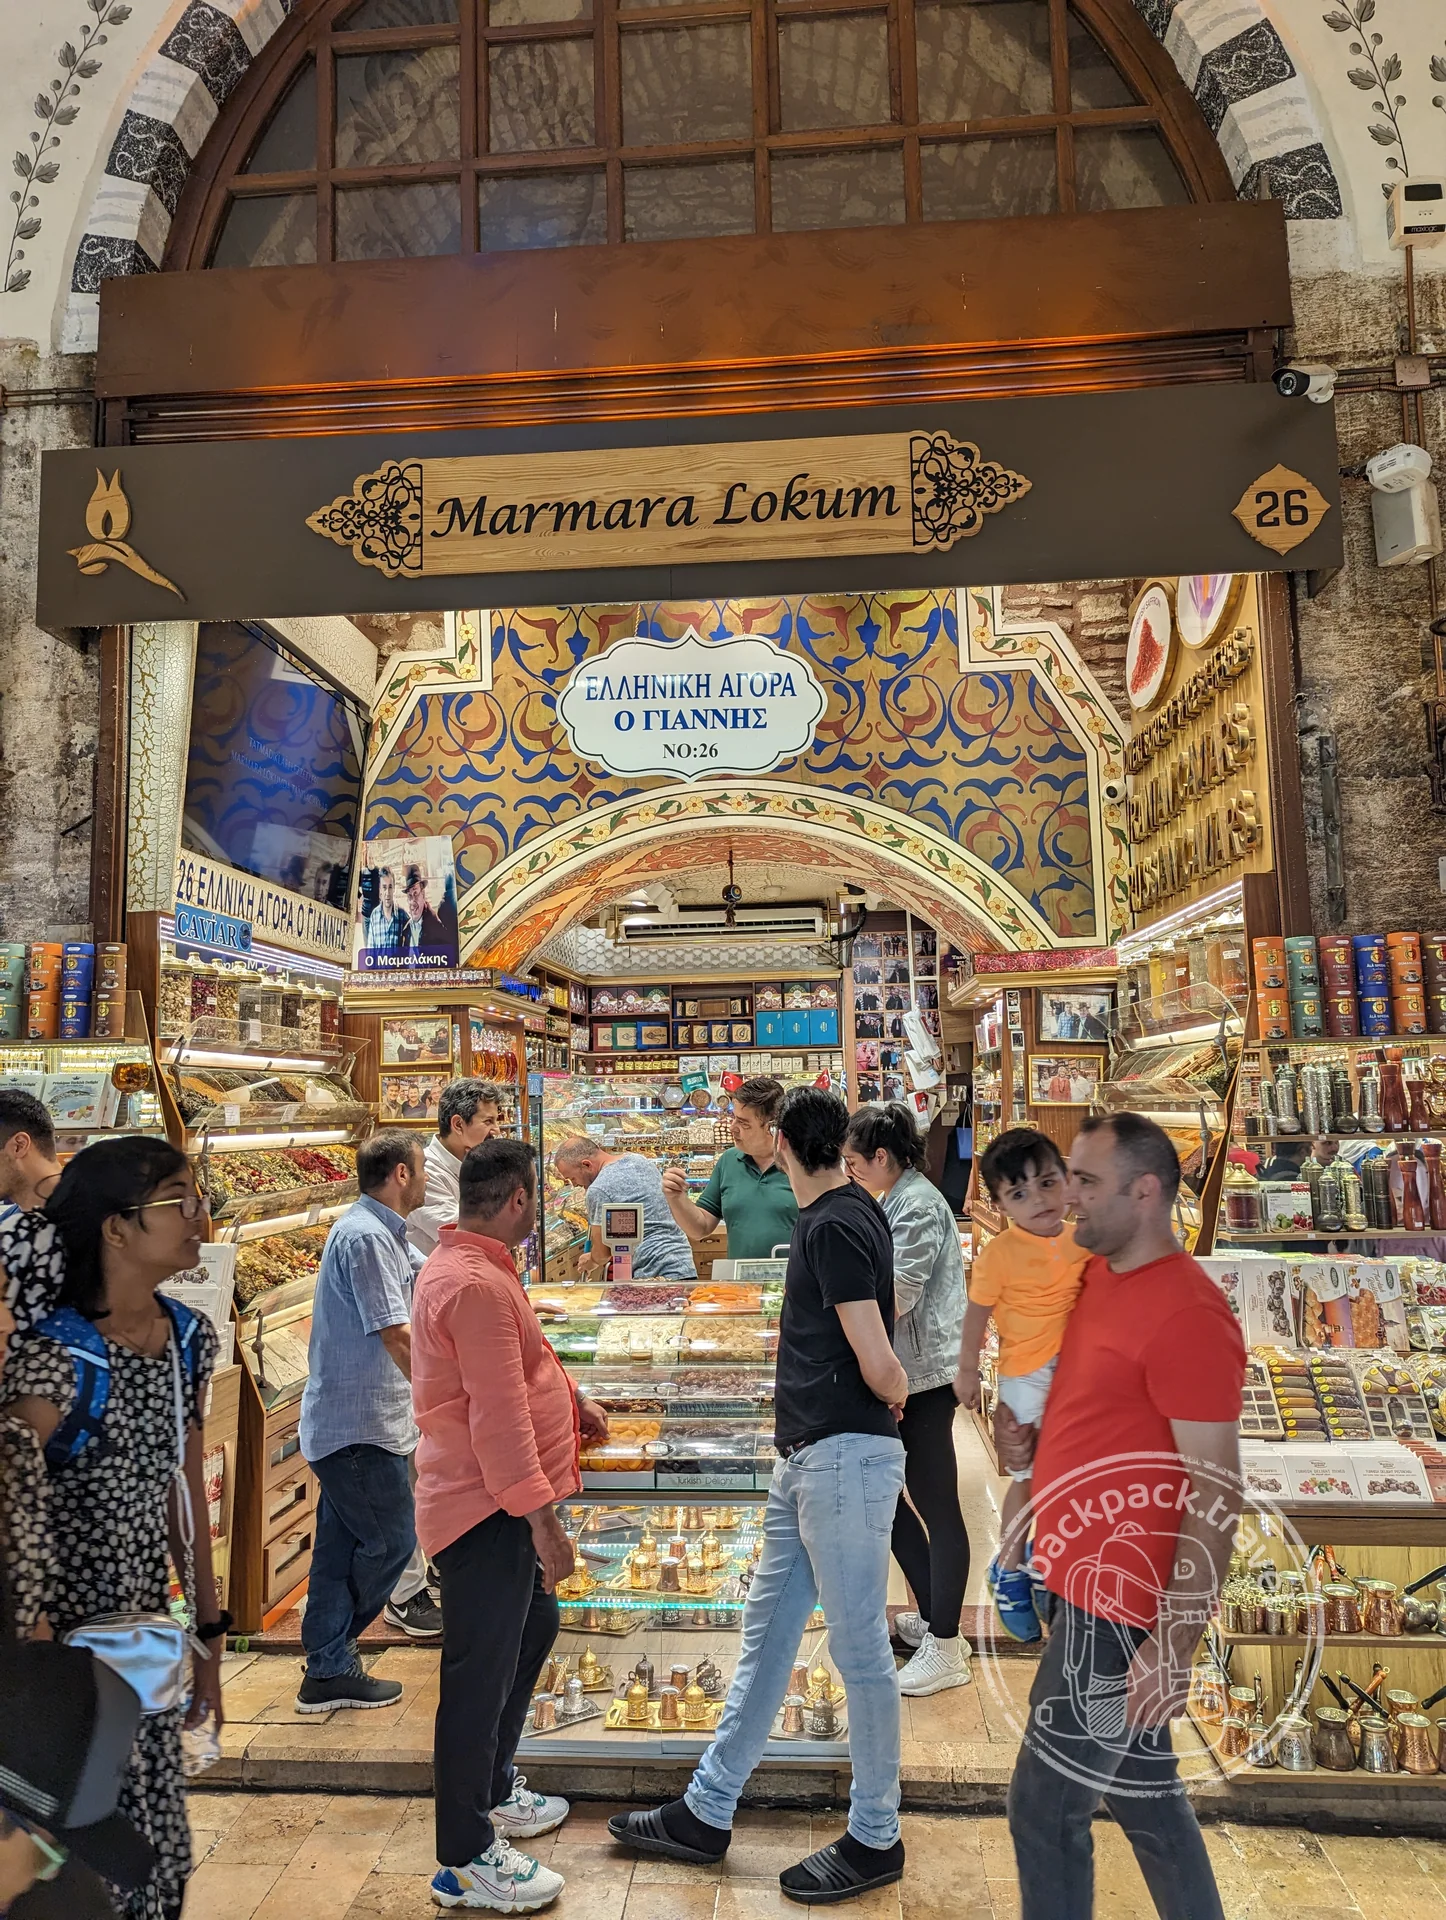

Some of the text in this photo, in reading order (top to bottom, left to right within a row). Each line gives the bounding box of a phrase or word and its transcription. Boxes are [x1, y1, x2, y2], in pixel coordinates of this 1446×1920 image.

[1411, 225, 1438, 233] maxlogic
[430, 473, 900, 538] Marmara Lokum
[1255, 489, 1309, 528] 26
[585, 672, 797, 701] ΕΛΛΗΝΙΚΗ ΑΓΟΡΑ
[614, 708, 768, 732] Ο ΓΙΑΝΝΗΣ
[662, 743, 719, 759] NO:26
[176, 858, 194, 902] 26
[256, 889, 294, 935] ΑΓΟΡΑ
[177, 912, 239, 948] CAVİAR
[364, 953, 448, 967] Ο Μαμαλάκης
[676, 1476, 734, 1487] Turkish Delight
